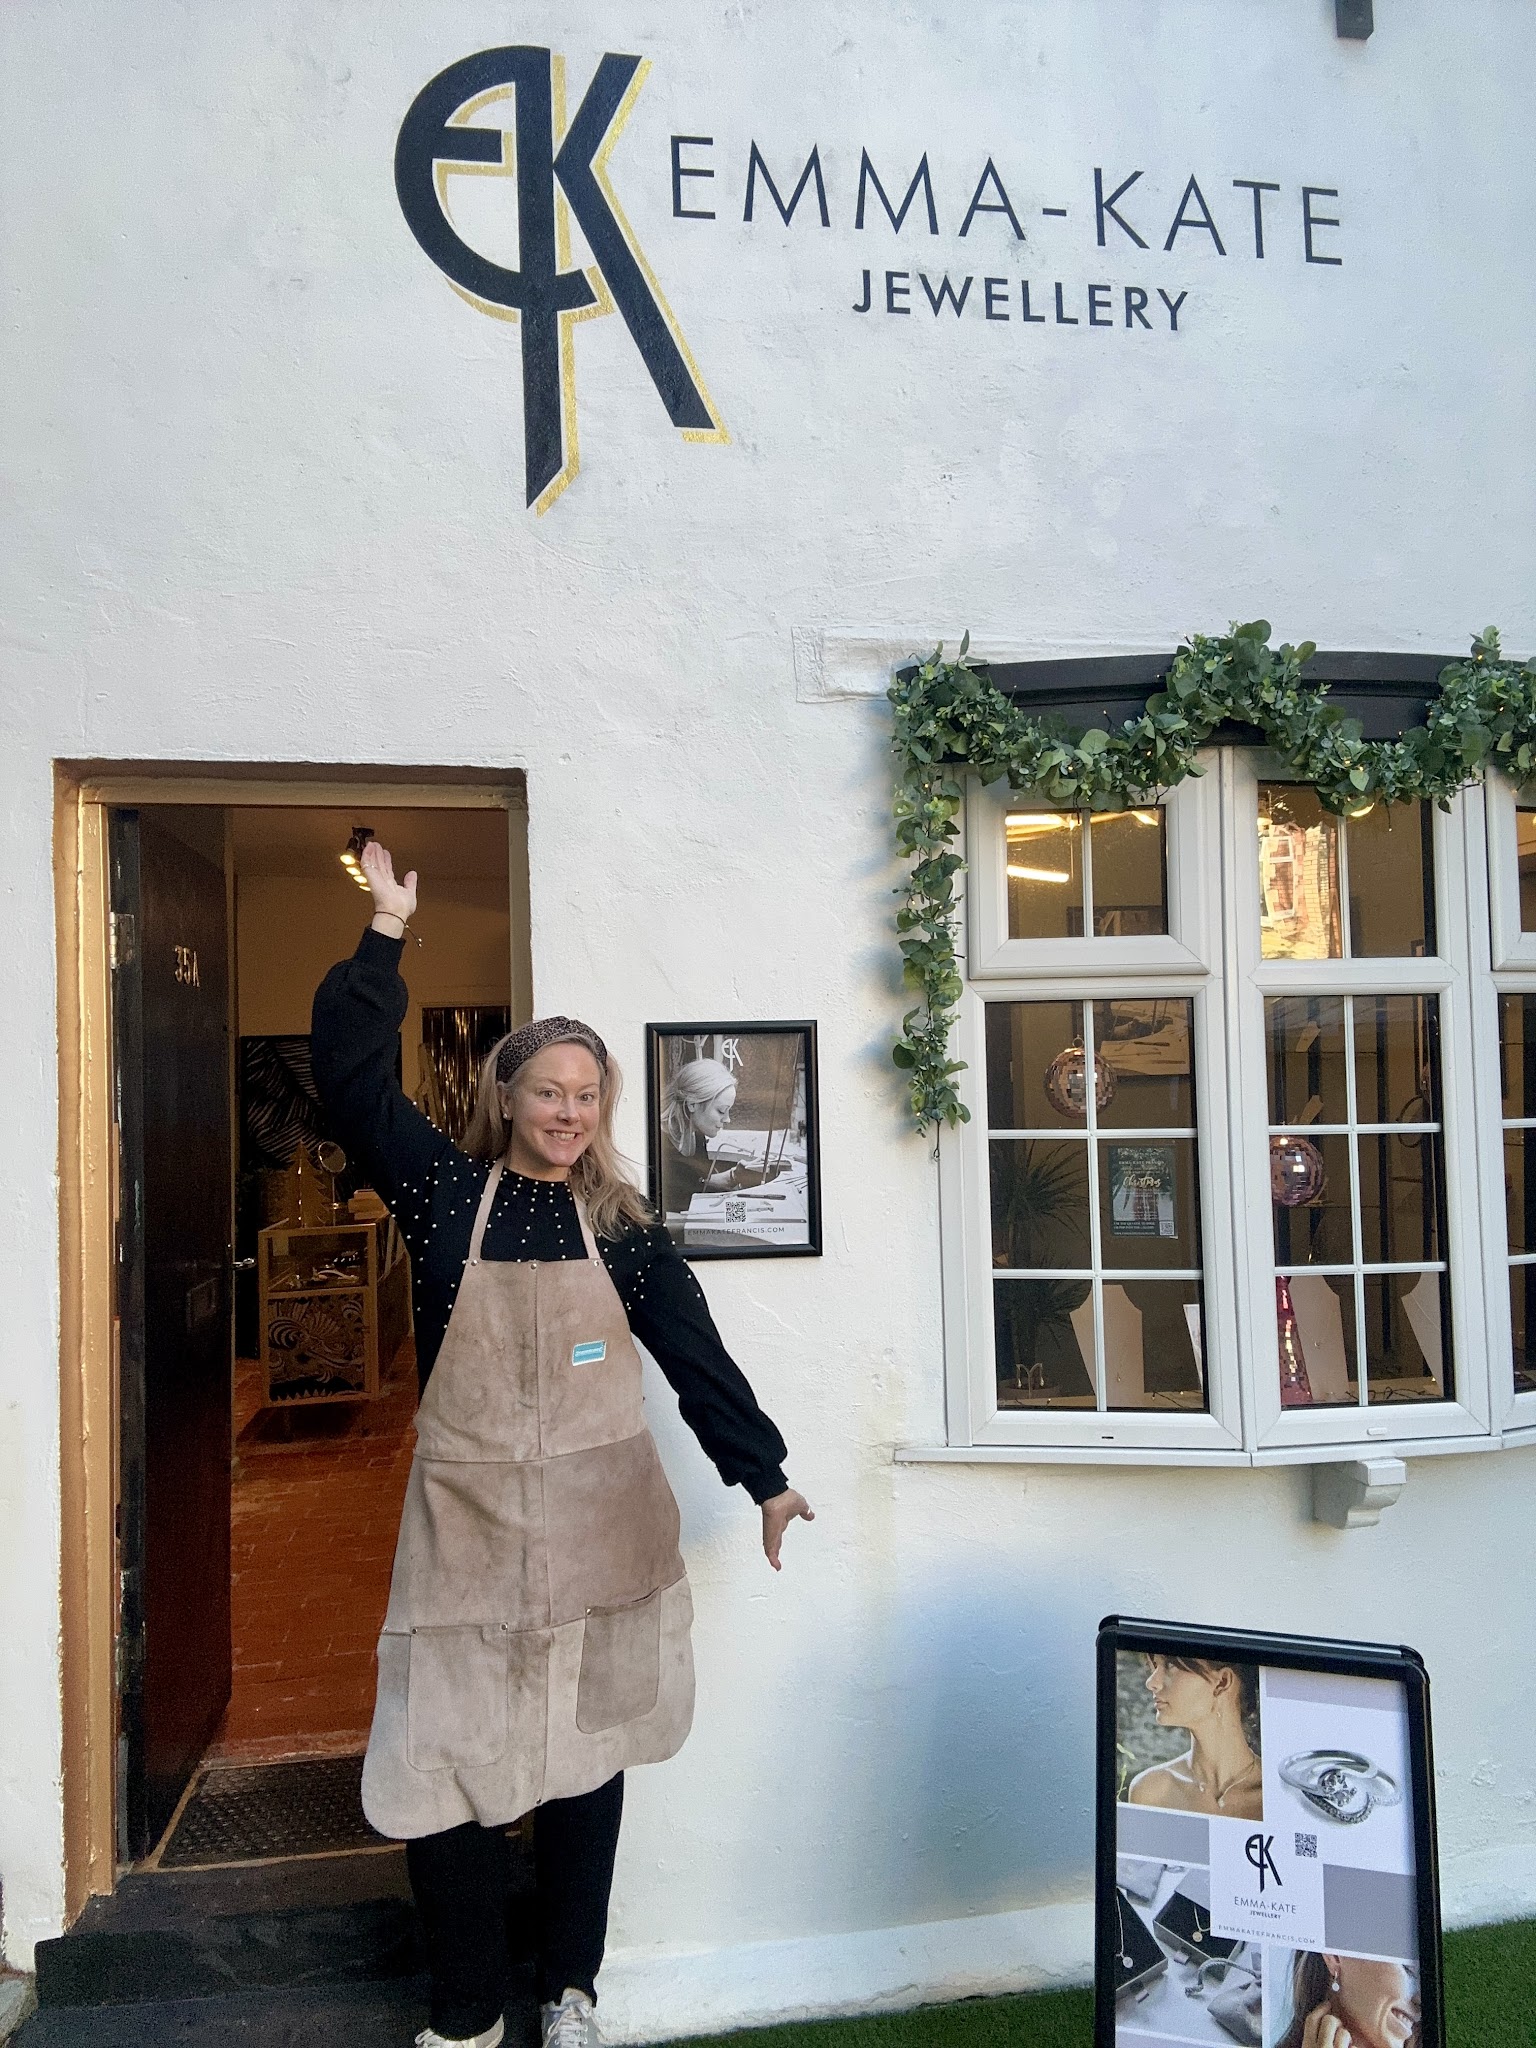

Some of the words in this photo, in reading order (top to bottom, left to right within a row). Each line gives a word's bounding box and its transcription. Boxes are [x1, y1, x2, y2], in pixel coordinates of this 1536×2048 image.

[670, 134, 1344, 266] EMMA-KATE
[851, 268, 1190, 332] JEWELLERY
[174, 944, 200, 988] 35A
[687, 1226, 785, 1236] EMMAKATEFRANCIS.COM
[1250, 1910, 1281, 1919] JEWELLERY
[1218, 1924, 1316, 1944] EMMAKATEFRANCIS.COM
